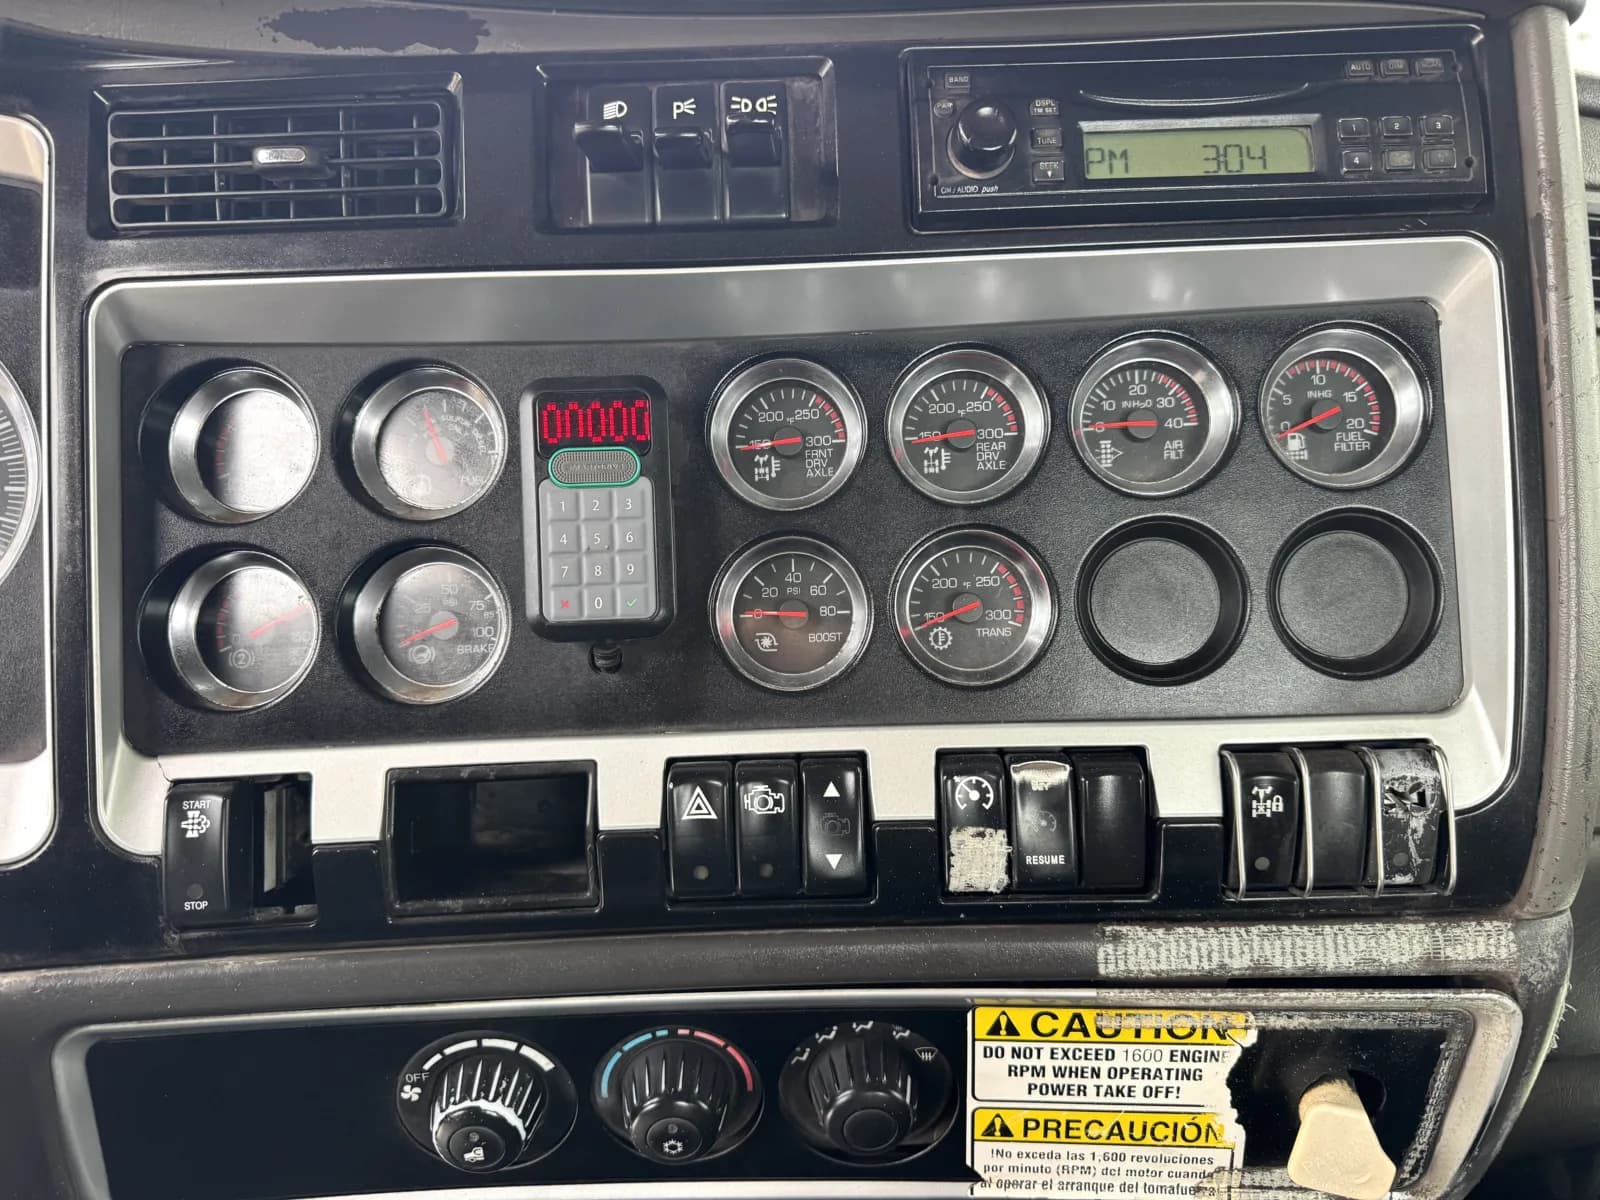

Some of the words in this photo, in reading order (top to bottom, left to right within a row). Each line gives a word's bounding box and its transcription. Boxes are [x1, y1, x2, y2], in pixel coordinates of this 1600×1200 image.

[1350, 63, 1371, 72] AUTO
[1394, 122, 1400, 130] 2
[1435, 121, 1442, 129] 3
[1037, 136, 1057, 145] TUNE
[1039, 161, 1059, 169] SEEK
[1085, 147, 1130, 175] PM
[1353, 156, 1360, 164] 4
[957, 185, 979, 194] AUDIO
[981, 184, 999, 194] push
[1311, 374, 1327, 386] 10
[1128, 384, 1147, 396] 20
[1156, 397, 1175, 408] 30
[1282, 394, 1293, 406] 5
[1343, 391, 1358, 403] 15
[928, 402, 955, 414] 200
[966, 400, 992, 412] 250
[1100, 400, 1116, 411] 10
[758, 410, 784, 422] 200
[794, 408, 820, 420] 250
[1164, 417, 1184, 429] 40
[1280, 421, 1291, 432] 0
[1345, 417, 1365, 430] 20
[976, 427, 1004, 439] 300
[1335, 432, 1366, 442] FUEL
[805, 435, 832, 447] 300
[1163, 440, 1184, 450] AIR
[1334, 441, 1371, 452] FILTER
[976, 442, 1006, 452] REAR
[805, 448, 834, 458] FRNT
[976, 452, 1000, 461] DRV
[1163, 449, 1185, 460] FILT
[805, 458, 828, 468] DRV
[976, 461, 1006, 471] AXLE
[806, 467, 834, 478] AXLE
[560, 501, 566, 512] 1
[592, 500, 600, 511] 2
[624, 499, 632, 510] 3
[559, 533, 568, 545] 4
[593, 532, 600, 544] 5
[625, 531, 633, 543] 6
[561, 566, 569, 577] 7
[594, 565, 602, 577] 8
[626, 563, 635, 575] 9
[785, 572, 802, 584] 40
[931, 578, 958, 589] 200
[975, 576, 1000, 587] 250
[440, 584, 459, 595] 50
[761, 586, 779, 598] 20
[786, 587, 801, 595] PSI
[810, 585, 827, 596] 60
[469, 599, 485, 611] 75
[594, 597, 603, 609] 0
[819, 605, 837, 617] 80
[985, 609, 1012, 621] 300
[473, 626, 495, 638] 100
[808, 632, 843, 643] BOOST
[976, 627, 1012, 638] TRANS
[457, 643, 496, 655] BRAKE
[182, 800, 211, 810] START
[1025, 855, 1066, 865] RESUME
[184, 900, 208, 911] STOP
[1030, 1011, 1228, 1041] CAUTION
[983, 1046, 1005, 1060] DO
[1010, 1046, 1044, 1061] NOT
[1050, 1047, 1116, 1062] EXCEED
[1122, 1048, 1163, 1063] 1600
[405, 1072, 430, 1083] OFF
[1007, 1065, 1046, 1079] RPM
[1053, 1065, 1102, 1080] WHEN
[1107, 1066, 1204, 1082] OPERATING
[1027, 1083, 1089, 1098] POWER
[1093, 1084, 1137, 1099] TAKE
[1142, 1085, 1181, 1100] OFF!
[1022, 1116, 1224, 1143] PRECAUCIÓN
[991, 1148, 1013, 1159] !No
[1016, 1150, 1061, 1160] exceda
[1066, 1151, 1085, 1161] las
[1090, 1152, 1126, 1163] 1,600
[1130, 1153, 1215, 1166] revoluciones
[983, 1164, 1004, 1174] por
[1008, 1164, 1052, 1174] minuto
[1056, 1164, 1097, 1178] (RPM)
[1125, 1168, 1164, 1179] motor
[996, 1178, 1038, 1192] operar
[1041, 1178, 1053, 1191] el
[1057, 1180, 1115, 1195] arranque
[1119, 1180, 1139, 1194] del
